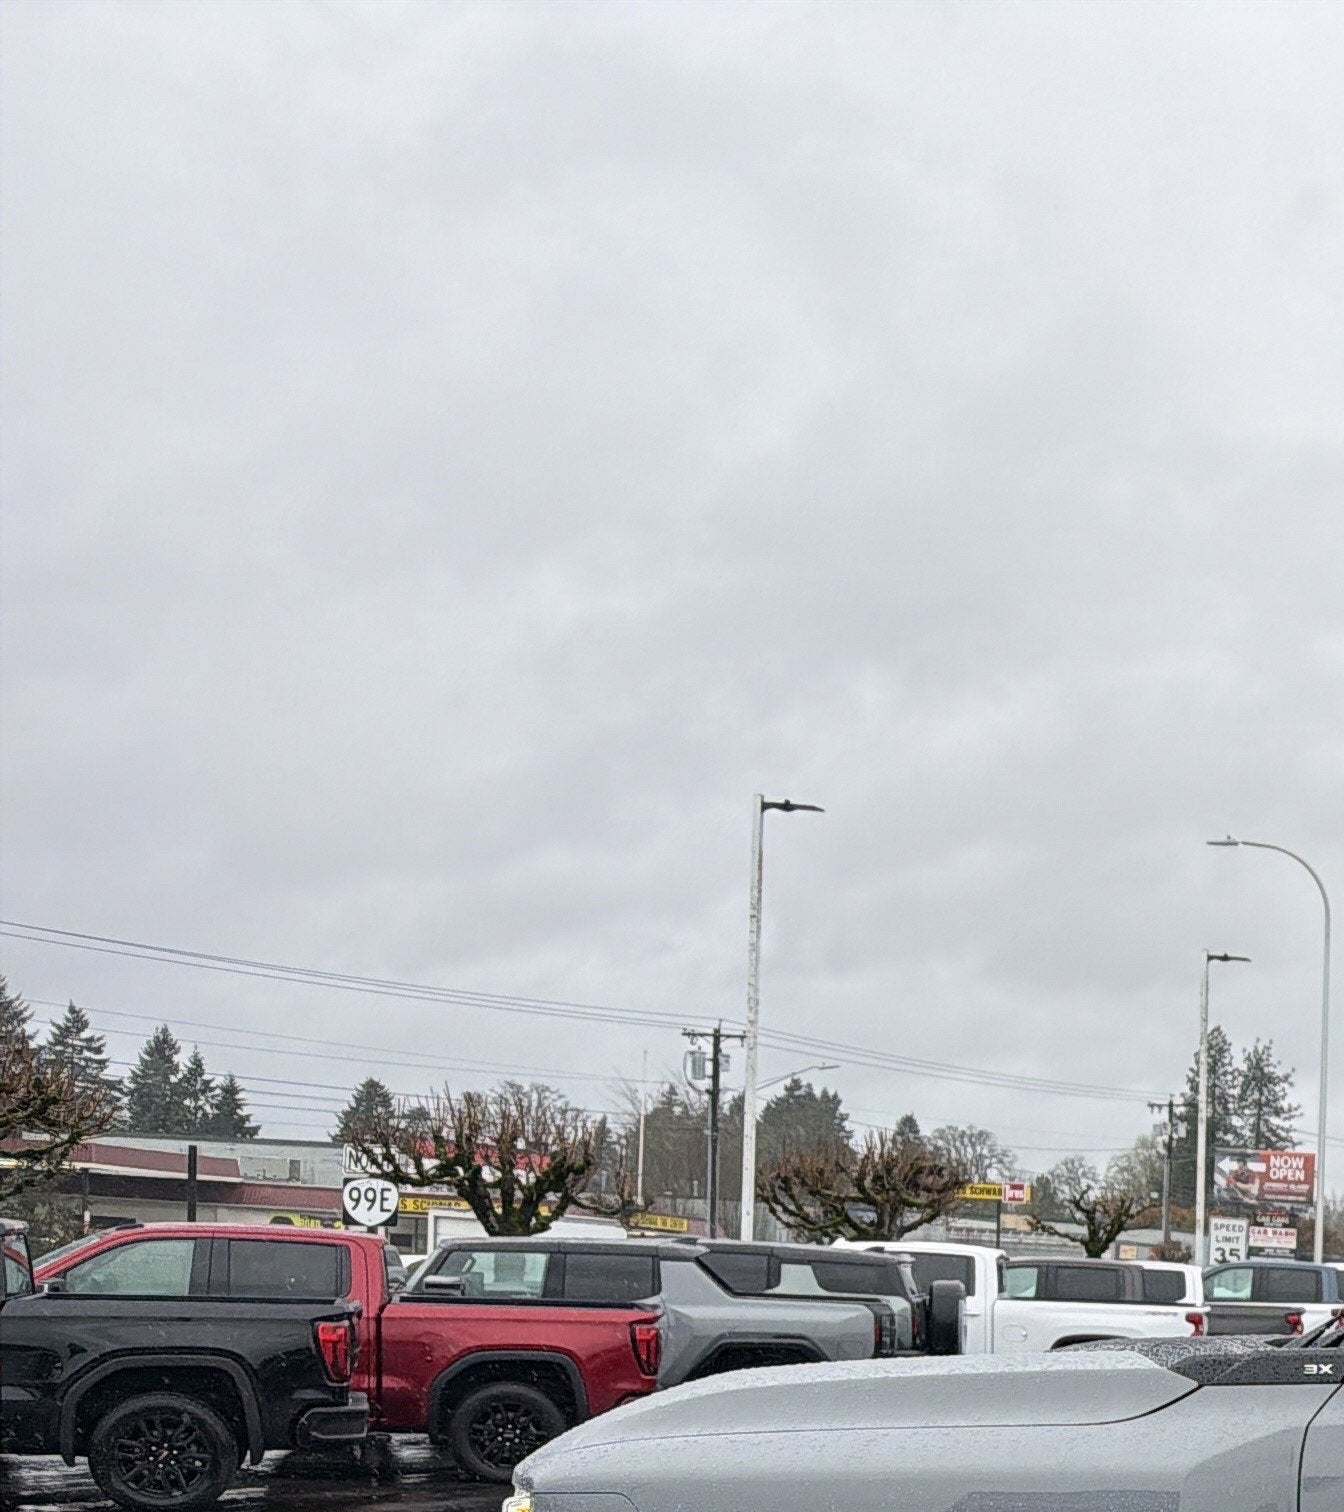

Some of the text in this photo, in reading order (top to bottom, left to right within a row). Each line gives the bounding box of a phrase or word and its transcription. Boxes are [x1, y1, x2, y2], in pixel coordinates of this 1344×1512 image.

[1269, 1154, 1305, 1169] NOW
[1269, 1167, 1305, 1182] OPEN
[348, 1186, 392, 1213] 99E
[1213, 1223, 1245, 1233] SPEED
[1214, 1235, 1241, 1244] LIMIT
[1214, 1247, 1241, 1264] 35
[1302, 1363, 1335, 1375] 3X
